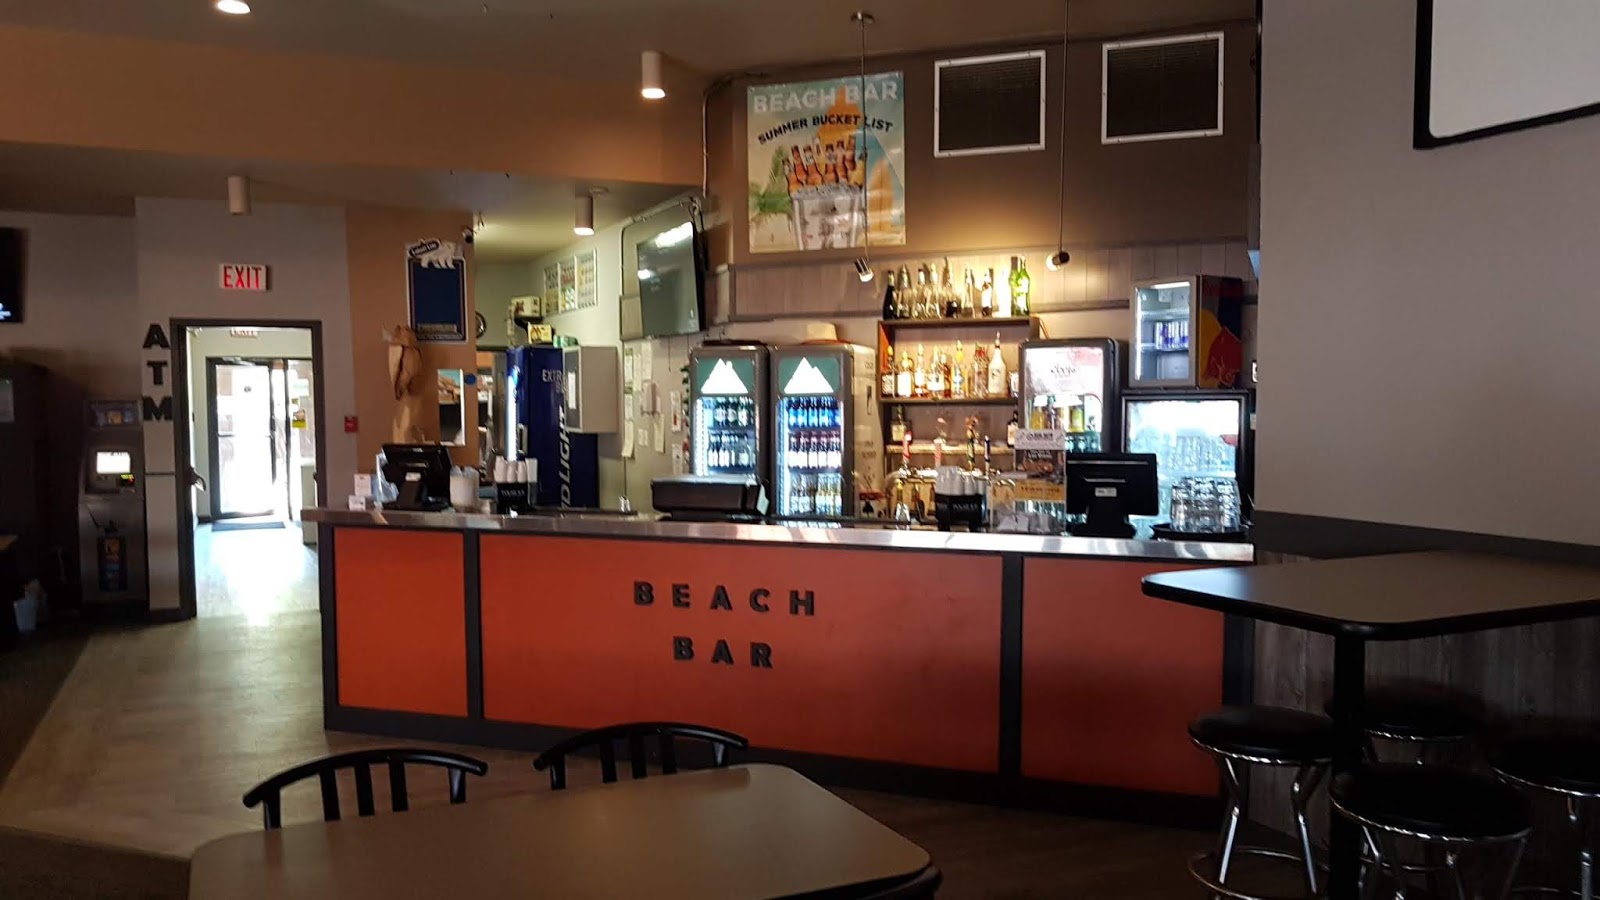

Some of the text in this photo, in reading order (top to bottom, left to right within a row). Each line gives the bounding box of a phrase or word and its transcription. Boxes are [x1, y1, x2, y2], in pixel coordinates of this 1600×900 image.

[754, 81, 898, 113] BEACH BAR
[758, 114, 894, 145] SUMMER BUCKET LIST
[223, 265, 262, 289] EXIT
[142, 323, 172, 421] ATM
[633, 580, 815, 616] BEACH
[673, 635, 773, 669] BAR
